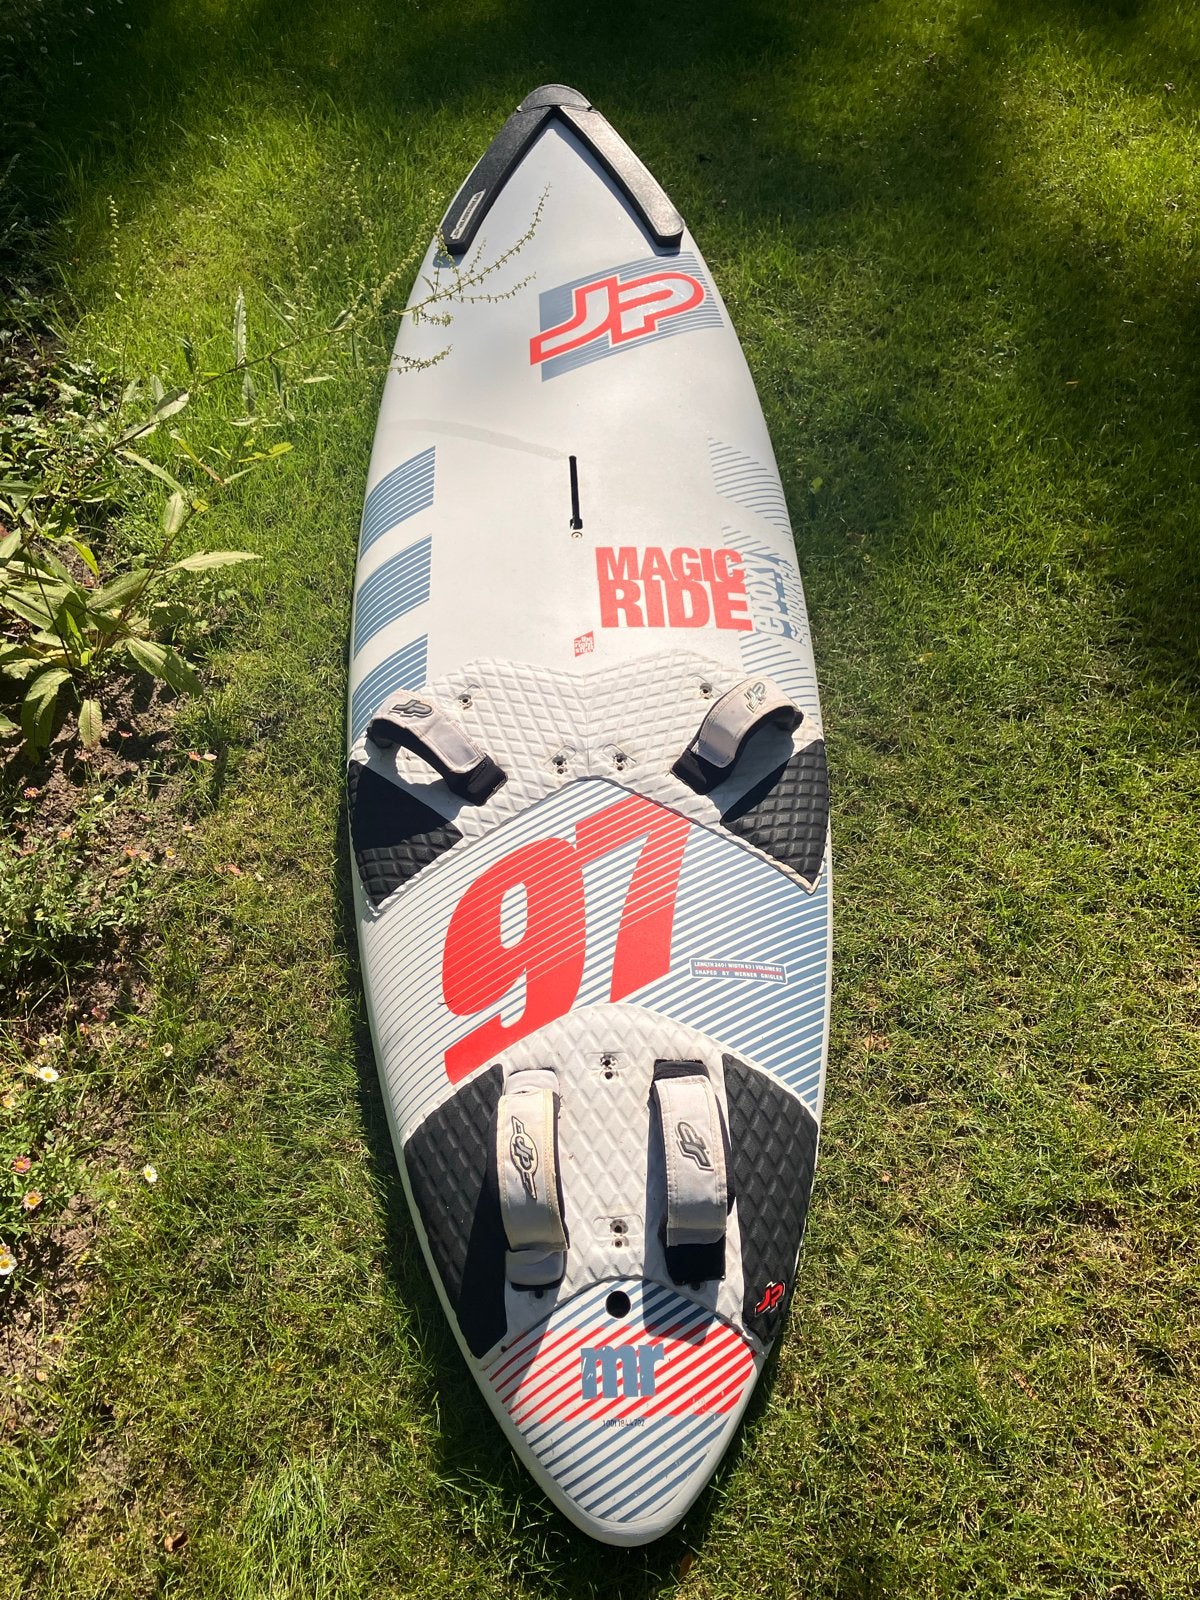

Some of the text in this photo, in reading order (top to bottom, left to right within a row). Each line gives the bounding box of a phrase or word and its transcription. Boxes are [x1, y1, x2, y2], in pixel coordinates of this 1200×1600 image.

[529, 271, 705, 366] JP
[595, 547, 745, 583] MAGIC
[744, 548, 790, 634] epoxy
[598, 579, 753, 631] RIDE
[442, 794, 692, 1086] 97
[754, 1281, 786, 1317] JP
[580, 1343, 665, 1400] mr
